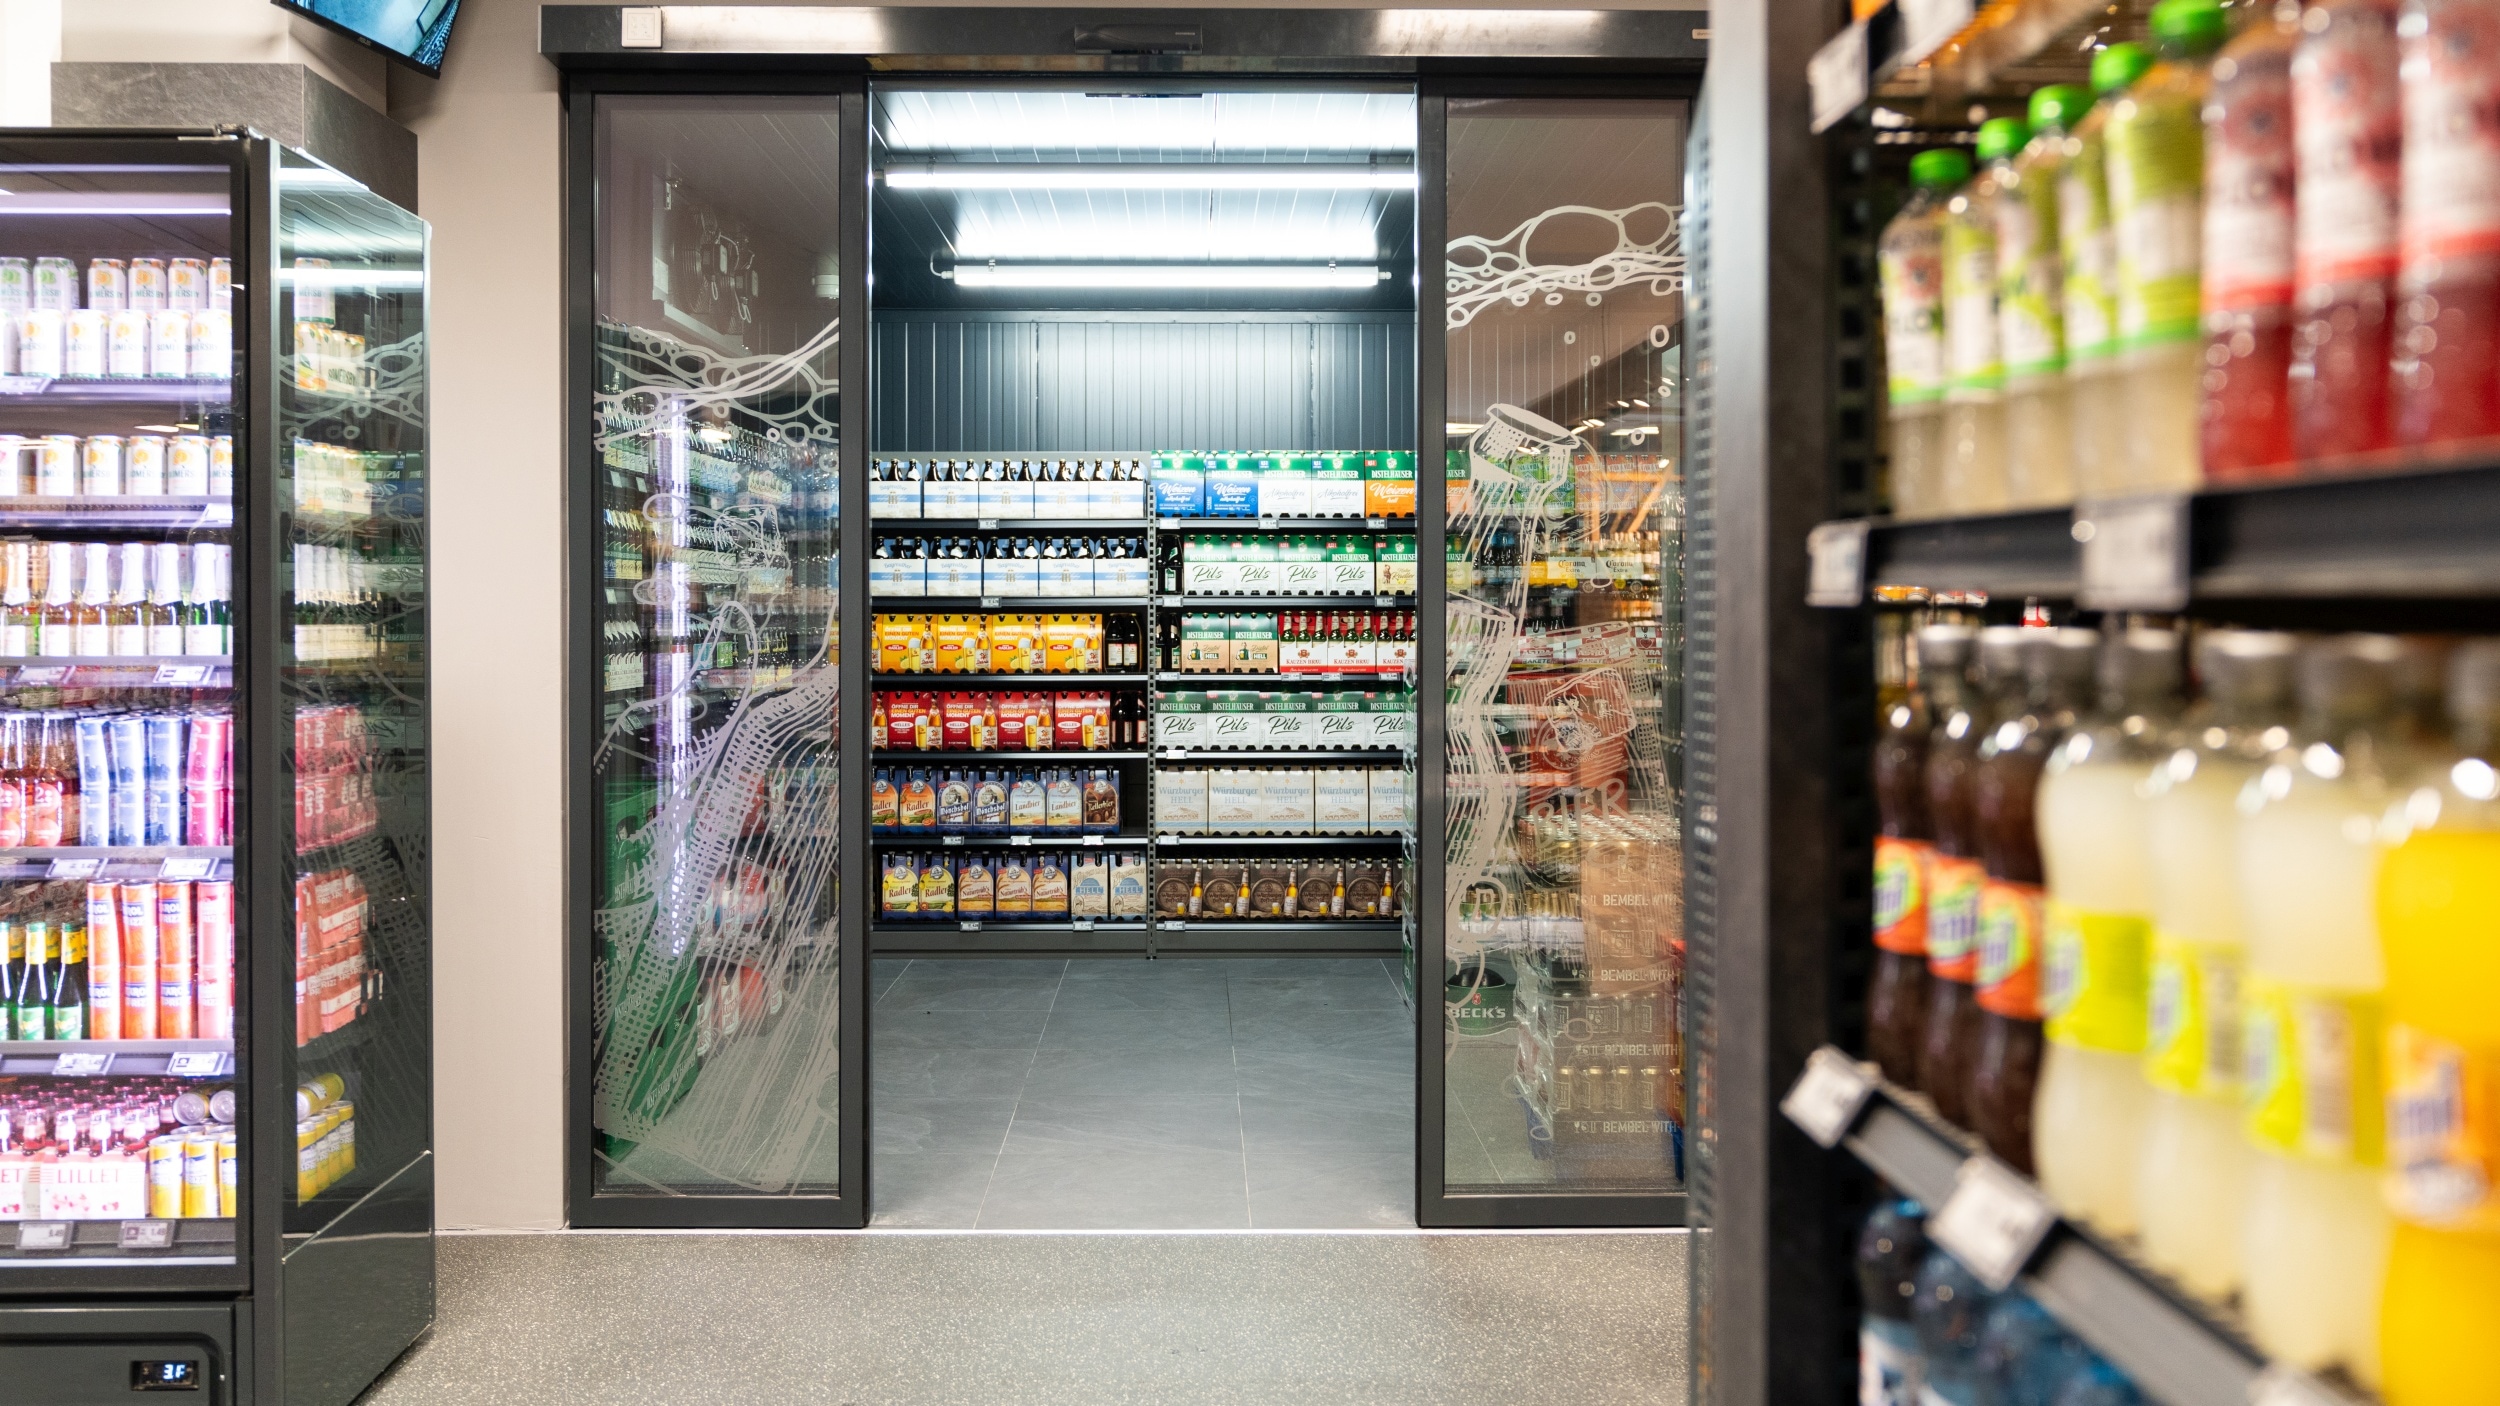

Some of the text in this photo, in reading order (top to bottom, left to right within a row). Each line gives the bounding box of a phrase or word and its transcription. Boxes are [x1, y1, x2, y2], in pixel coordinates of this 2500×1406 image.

[1158, 483, 1197, 497] Weizen
[1213, 483, 1251, 497] Weizen
[1369, 483, 1415, 498] Weizen
[1606, 560, 1633, 568] Corona
[1193, 565, 1223, 582] Pils
[1240, 565, 1271, 582] Pils
[1287, 565, 1318, 582] Pils
[1335, 565, 1366, 582] Pils
[1163, 716, 1196, 735] Pils
[1216, 715, 1249, 734] Pils
[1268, 715, 1301, 734] Pils
[1321, 715, 1355, 734] Pils
[1159, 787, 1205, 796] Würzburger
[1212, 787, 1258, 796] Würzburger
[1264, 787, 1310, 796] Würzburger
[1318, 787, 1364, 796] Würzburger
[906, 800, 929, 812] Radler
[941, 803, 969, 816] Mönchshof
[977, 803, 1005, 816] Mönchshof
[1015, 800, 1040, 811] Landbier
[1052, 800, 1076, 811] Landbier
[1088, 800, 1114, 811] Kellerbier
[889, 886, 911, 898] Radler
[925, 886, 948, 898] Radler
[1079, 886, 1101, 894] HELL
[1119, 886, 1141, 894] HELL
[1450, 1006, 1506, 1018] BECK'S
[58, 1168, 119, 1183] LILLET
